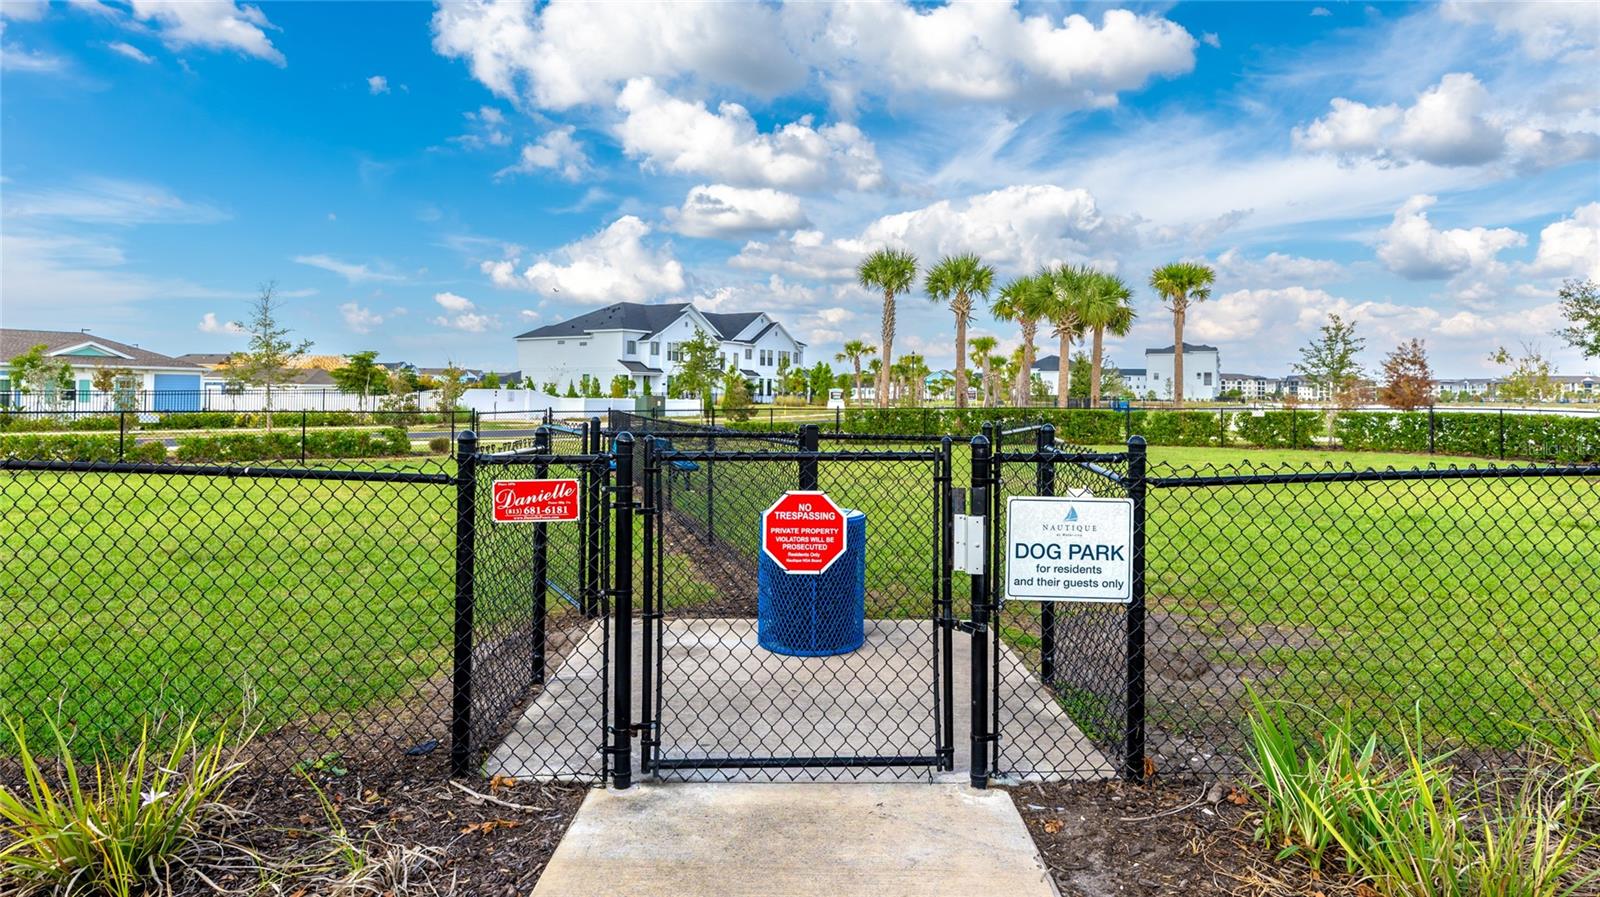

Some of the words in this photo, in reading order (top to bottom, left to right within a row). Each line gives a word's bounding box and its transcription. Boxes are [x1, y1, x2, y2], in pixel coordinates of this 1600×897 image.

[495, 483, 576, 509] Danielle
[506, 508, 522, 516] (813)
[524, 506, 568, 514] 681-6181
[798, 503, 812, 512] NO
[774, 512, 836, 520] TRESPASSING
[1042, 524, 1098, 532] NAUTIQUE
[1015, 543, 1061, 560] DOG
[1069, 544, 1125, 561] PARK
[1036, 564, 1051, 574] for
[1053, 564, 1102, 574] residents
[1014, 578, 1034, 586] and
[1036, 578, 1060, 587] their
[1063, 580, 1099, 589] guests
[1102, 579, 1124, 590] only
